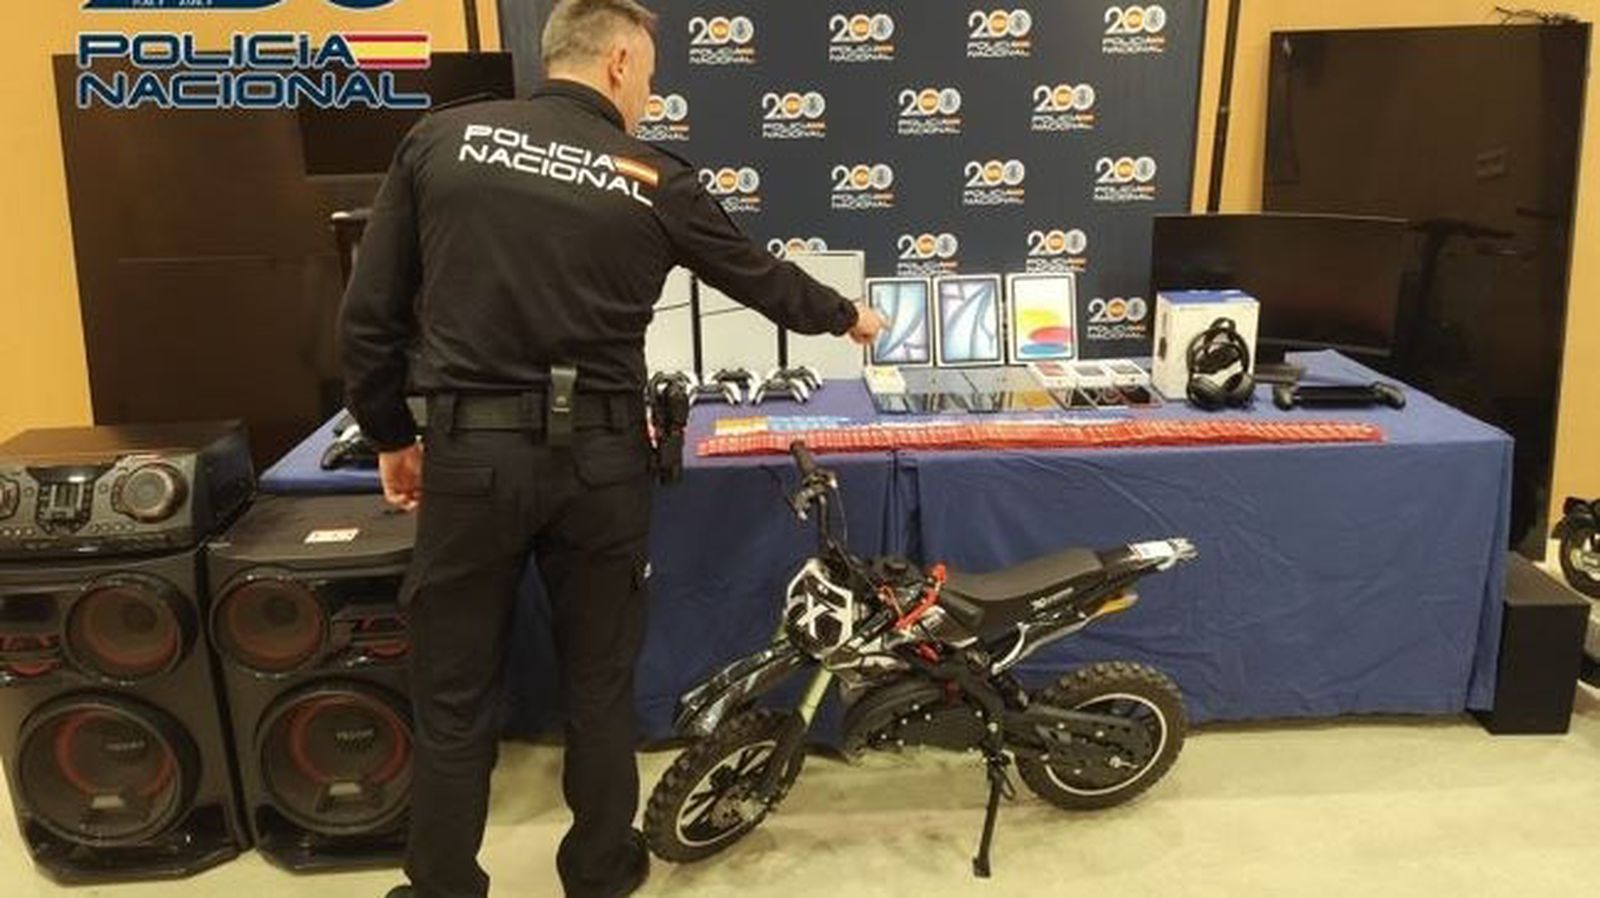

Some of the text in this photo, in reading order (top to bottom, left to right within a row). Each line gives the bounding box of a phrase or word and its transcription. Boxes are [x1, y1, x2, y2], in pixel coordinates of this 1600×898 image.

[689, 16, 754, 44] 200
[829, 13, 894, 43] 200
[968, 9, 1032, 38] 200
[1104, 4, 1166, 35] 200
[762, 91, 826, 120] 200
[899, 87, 961, 116] 200
[1033, 83, 1095, 112] 200
[464, 124, 616, 172] POLICIA
[459, 144, 653, 207] NACIONAL
[831, 163, 893, 191] 200
[964, 159, 1025, 188] 200
[1095, 155, 1156, 183] 200
[897, 232, 958, 259] 200
[1027, 229, 1087, 256] 200
[1088, 297, 1147, 322] 200
